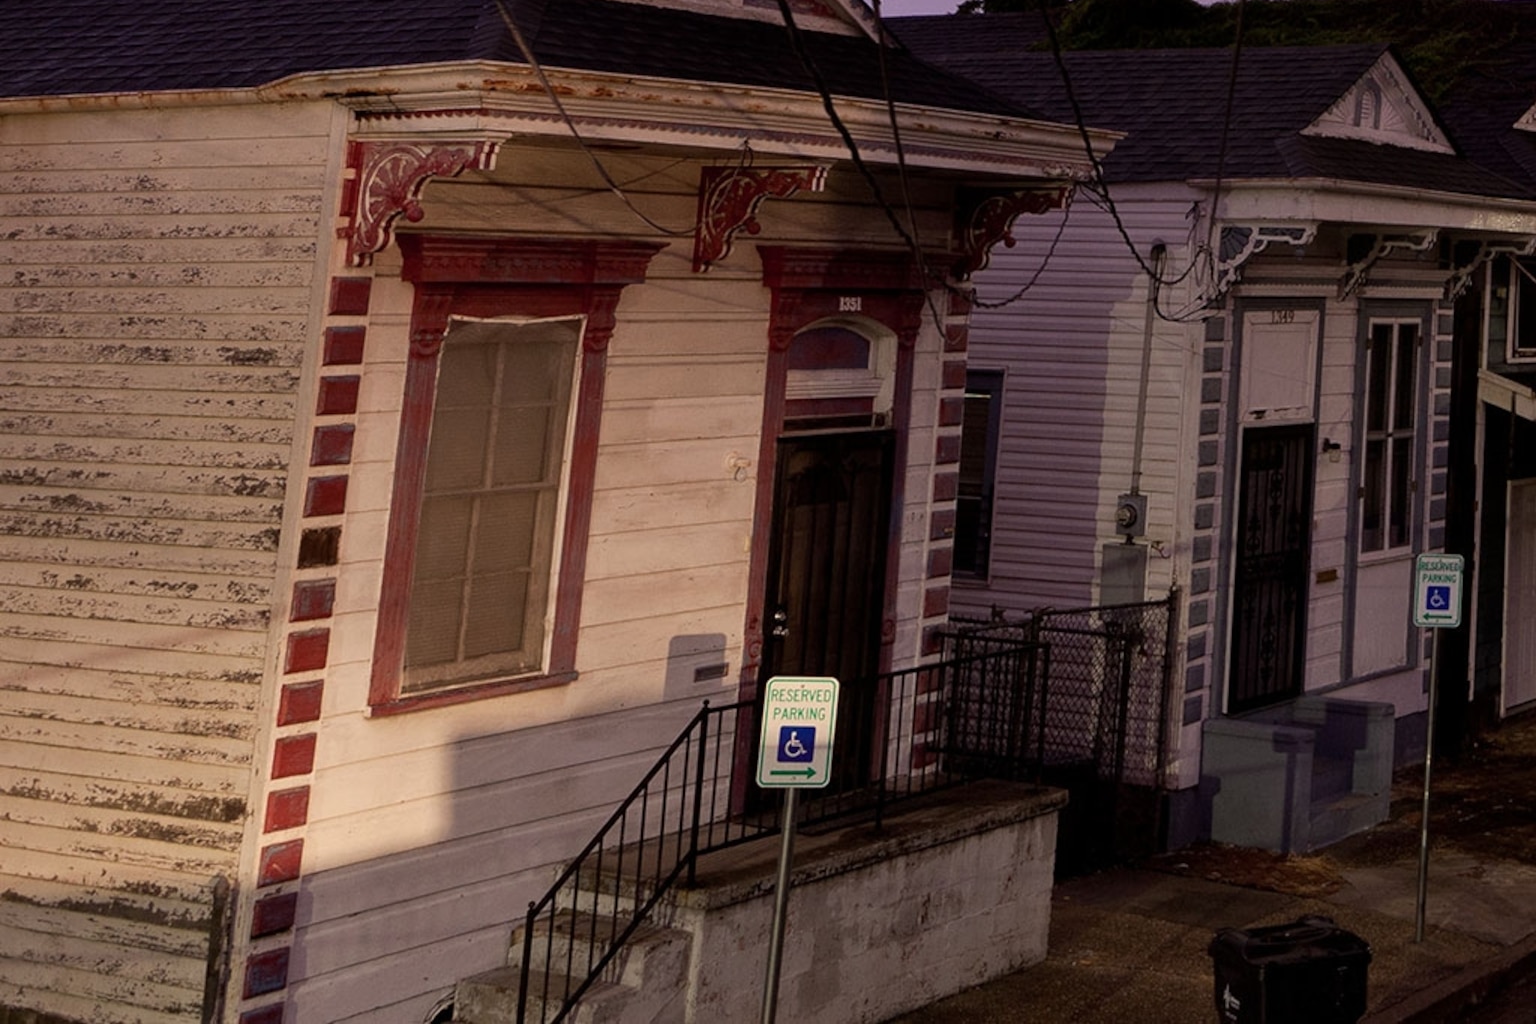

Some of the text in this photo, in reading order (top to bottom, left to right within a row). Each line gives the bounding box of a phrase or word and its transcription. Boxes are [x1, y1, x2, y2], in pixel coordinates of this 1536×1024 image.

[839, 296, 862, 312] 1351
[1418, 561, 1461, 572] RESERVED
[1422, 573, 1457, 584] PARKING
[770, 688, 832, 703] RESERVED
[773, 707, 827, 721] PARKING
